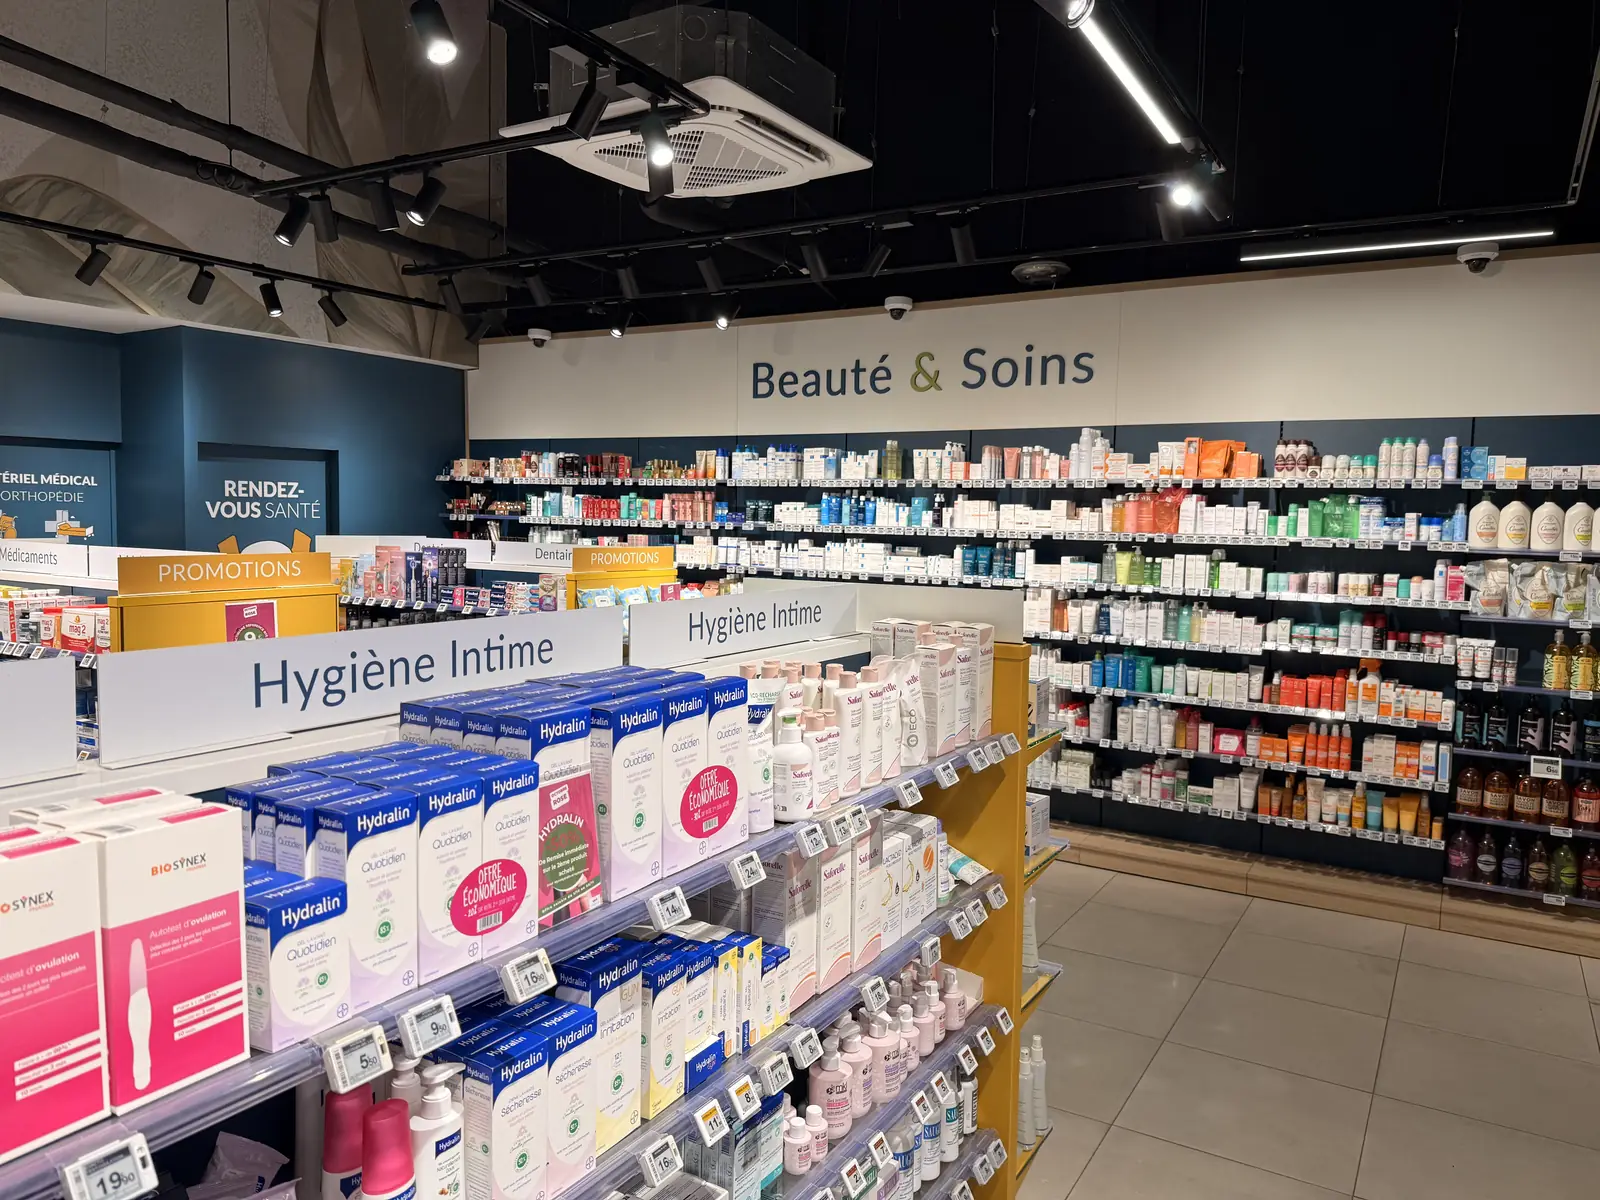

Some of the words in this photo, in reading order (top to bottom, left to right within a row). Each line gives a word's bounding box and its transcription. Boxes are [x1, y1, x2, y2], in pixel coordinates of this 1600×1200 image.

[752, 353, 892, 400] Beauté
[910, 351, 943, 393] &
[961, 344, 1095, 390] Soins
[40, 472, 98, 488] MÉDICAL
[223, 480, 305, 499] RENDEZ-
[0, 489, 85, 504] ORTHOPÉDIE
[205, 500, 262, 520] VOUS
[264, 499, 322, 520] SANTÉ
[0, 546, 58, 566] Médicaments
[535, 547, 573, 562] Dentair
[590, 551, 660, 566] PROMOTIONS
[158, 560, 302, 583] PROMOTIONS
[688, 606, 768, 646] Hygiène
[772, 600, 823, 627] Intime
[957, 654, 971, 664] Safor
[253, 650, 436, 711] Hygiène
[451, 633, 555, 680] Intime
[669, 697, 703, 719] Hydralin
[714, 686, 745, 709] Hydralin
[403, 710, 428, 725] Hydralin
[434, 715, 460, 729] Hydralin
[467, 720, 494, 734] Hydralin
[620, 708, 659, 733] Hydralin
[500, 723, 528, 737] Hydralin
[540, 717, 587, 744] Hydralin
[717, 726, 743, 741] Quotidien
[671, 736, 700, 754] Quotidien
[623, 752, 656, 769] Quotidien
[492, 772, 536, 798] Hydralin
[699, 768, 719, 789] OFFRE
[228, 793, 248, 808] Hydralin
[428, 786, 477, 814] Hydralin
[552, 793, 568, 806] ROSE
[688, 779, 731, 811] ÉCONOMIQUE
[258, 800, 276, 814] Hydral
[278, 809, 303, 825] Hydralin
[318, 814, 344, 830] Hydralin
[357, 806, 412, 835] Hydralin
[495, 813, 532, 833] Quotidien
[538, 813, 584, 842] HYDRALIN
[432, 829, 473, 851] Quotidien
[151, 852, 207, 877] BIOSYNEX
[361, 851, 406, 874] Quotidien
[570, 851, 588, 864] produit
[858, 847, 880, 866] Saforelle
[478, 861, 503, 885] OFFRE
[823, 861, 847, 882] Saforelle
[462, 872, 518, 908] ÉCONOMIQUE
[788, 877, 813, 899] Saforelle
[183, 908, 227, 929] d'ovulation
[281, 896, 342, 930] Hydralin
[286, 935, 338, 961] Quotidien
[26, 951, 80, 977] d'ovulation
[599, 957, 639, 989] Hydralin
[657, 962, 685, 988] Hydralin
[686, 955, 713, 977] Hydralin
[556, 1022, 594, 1051] Hydralin
[501, 1051, 543, 1083] Hydralin
[555, 1058, 593, 1085] Sécheresse
[695, 1053, 718, 1072] Hydralin
[467, 1066, 490, 1082] Hydralin
[500, 1087, 542, 1118] Sécheresse
